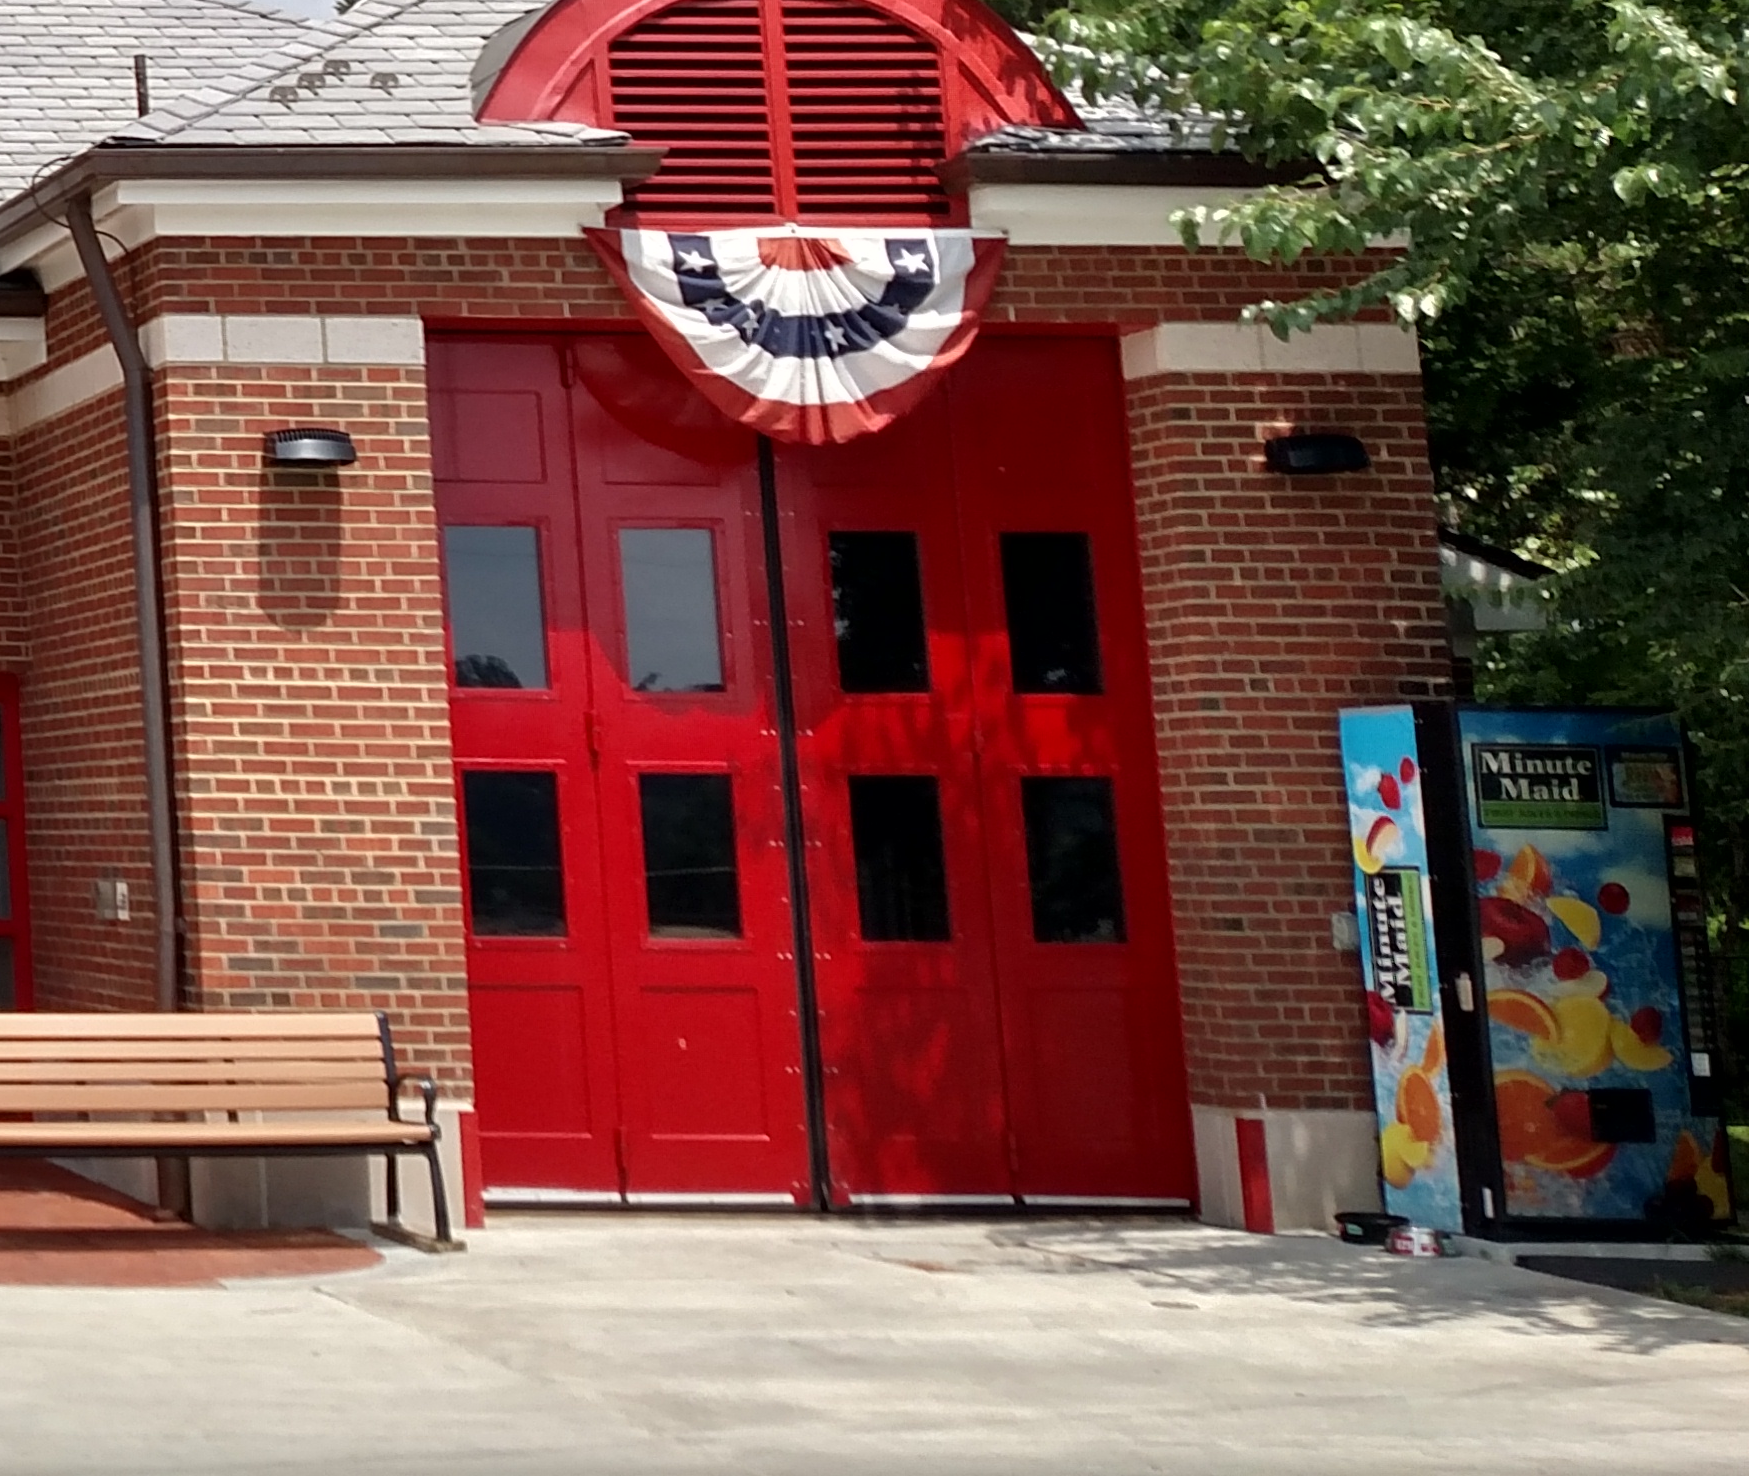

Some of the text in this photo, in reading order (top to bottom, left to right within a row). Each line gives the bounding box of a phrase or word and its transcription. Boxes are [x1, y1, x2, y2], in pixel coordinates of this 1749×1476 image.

[1479, 751, 1593, 776] Minute
[1499, 777, 1581, 801] Maid
[1372, 876, 1397, 1004] Minute
[1385, 891, 1412, 988] Maid
